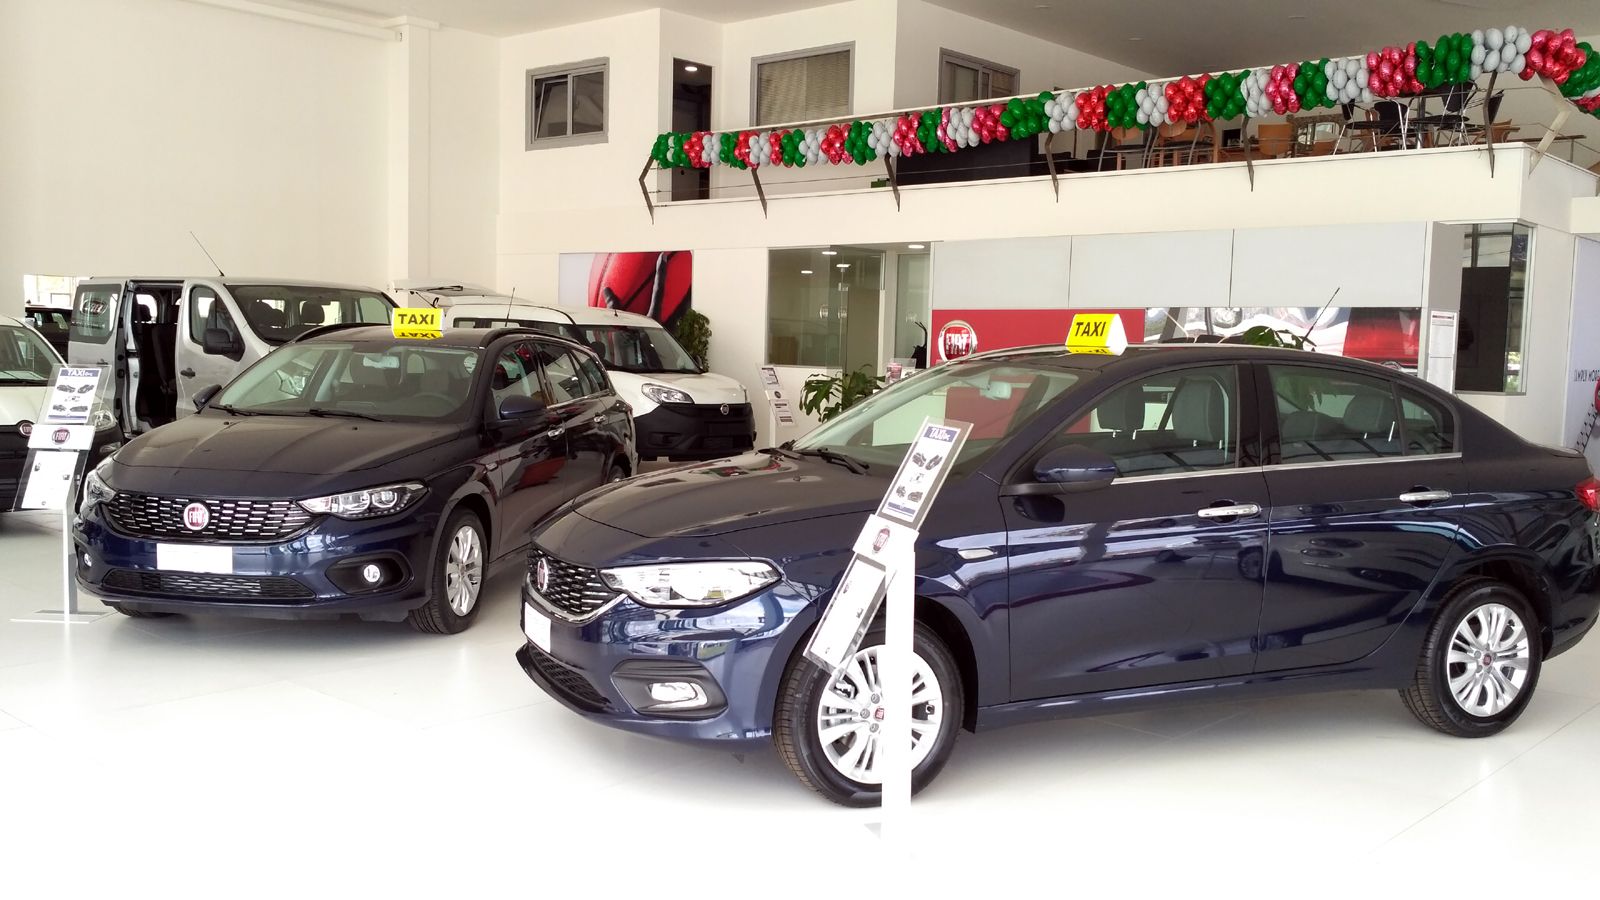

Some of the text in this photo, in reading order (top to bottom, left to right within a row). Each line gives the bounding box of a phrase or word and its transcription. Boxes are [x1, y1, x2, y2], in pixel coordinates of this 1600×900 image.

[398, 314, 434, 325] TAXI
[1074, 321, 1106, 337] TAXI
[945, 333, 970, 355] FIAT
